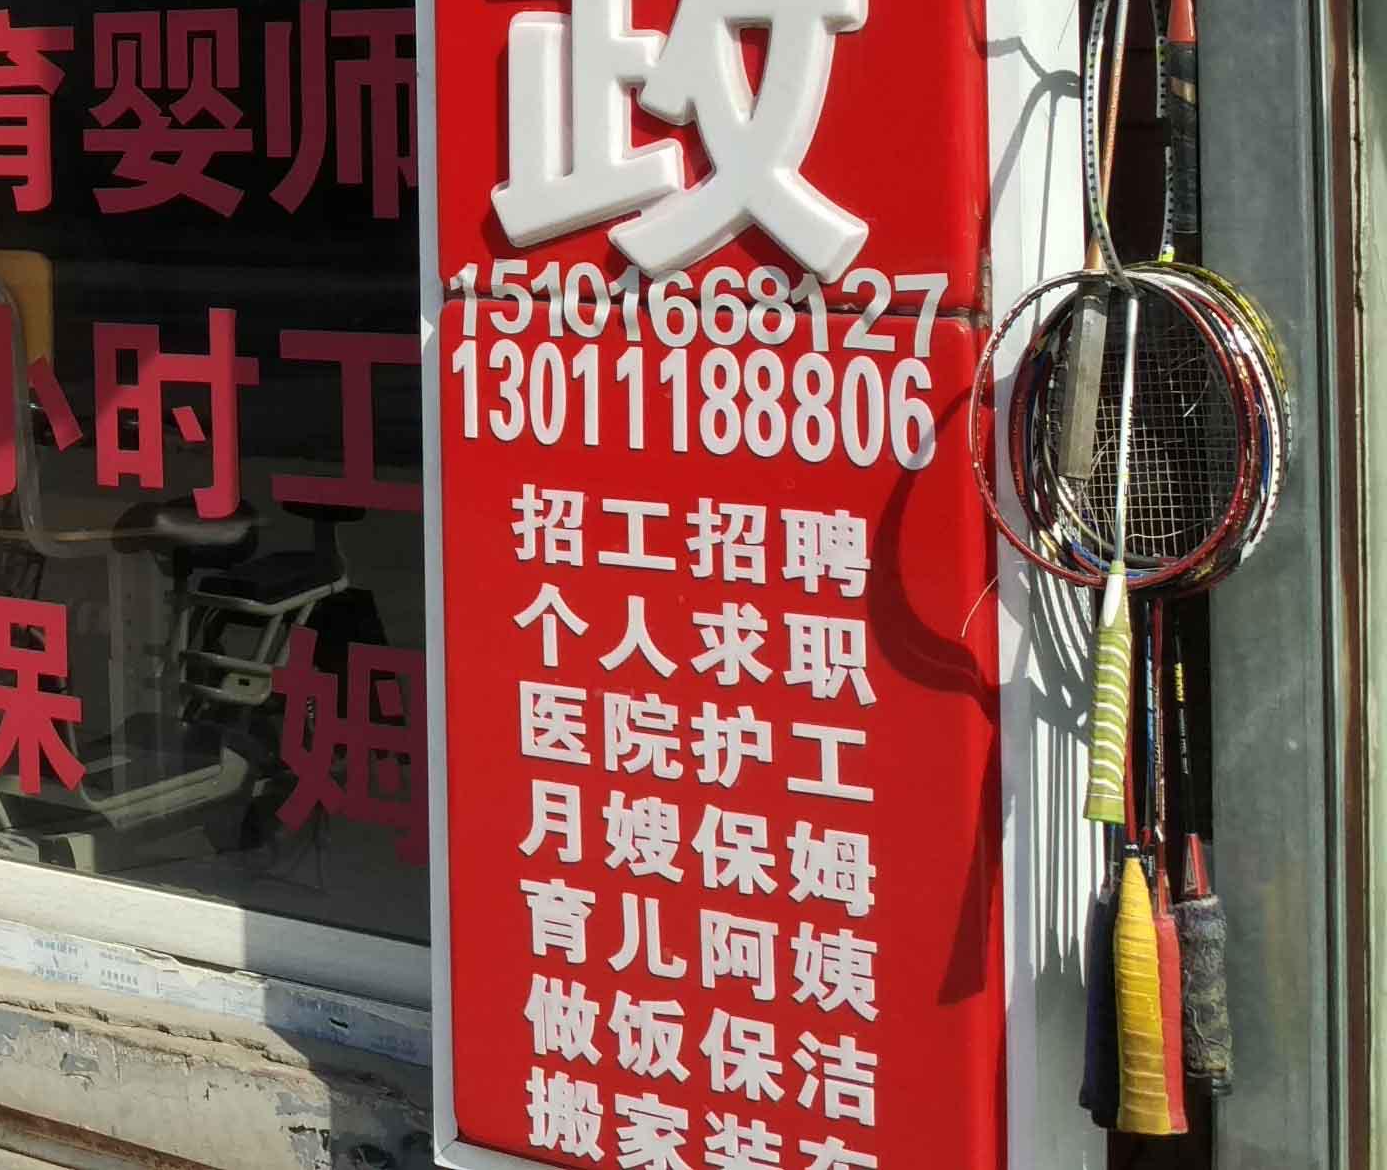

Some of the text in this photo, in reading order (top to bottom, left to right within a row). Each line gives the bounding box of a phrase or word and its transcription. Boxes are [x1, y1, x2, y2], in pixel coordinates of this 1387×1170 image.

[450, 258, 948, 358] 15101668127
[451, 339, 936, 470] 13011188806
[511, 484, 872, 598] 招工招聘
[513, 582, 877, 706] 个人求职
[518, 680, 875, 802] 医院护工
[518, 779, 877, 917] 月嫂保姆
[519, 877, 879, 1021] 育儿阿姨
[524, 973, 878, 1126] 做饭保洁
